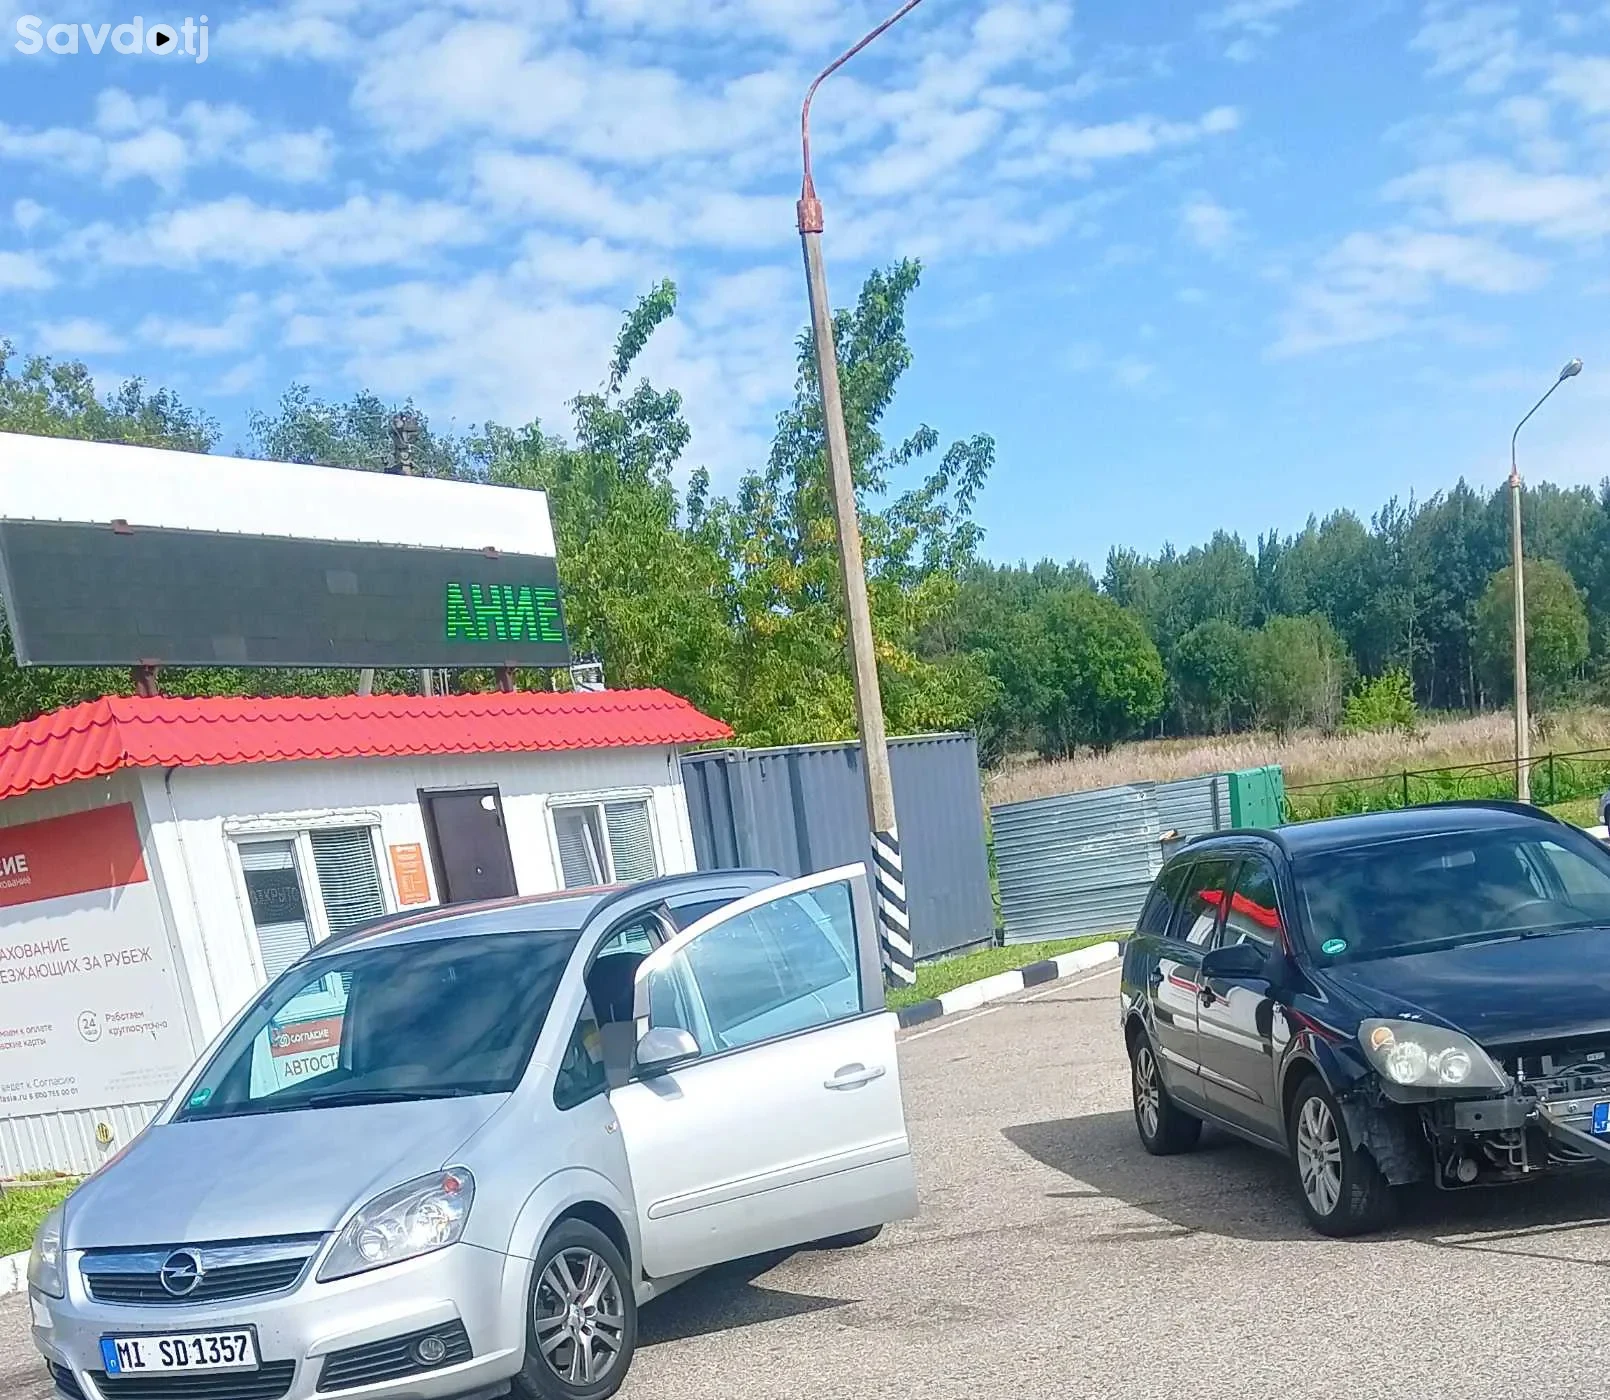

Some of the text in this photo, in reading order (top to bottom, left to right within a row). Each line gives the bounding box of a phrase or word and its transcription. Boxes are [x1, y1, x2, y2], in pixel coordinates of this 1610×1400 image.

[447, 583, 562, 641] АНИЕ
[0, 854, 29, 876] ИЕ
[84, 955, 102, 971] ЗА
[103, 946, 152, 968] РУБЕЖ
[82, 1018, 96, 1029] 24
[117, 1341, 146, 1369] MI
